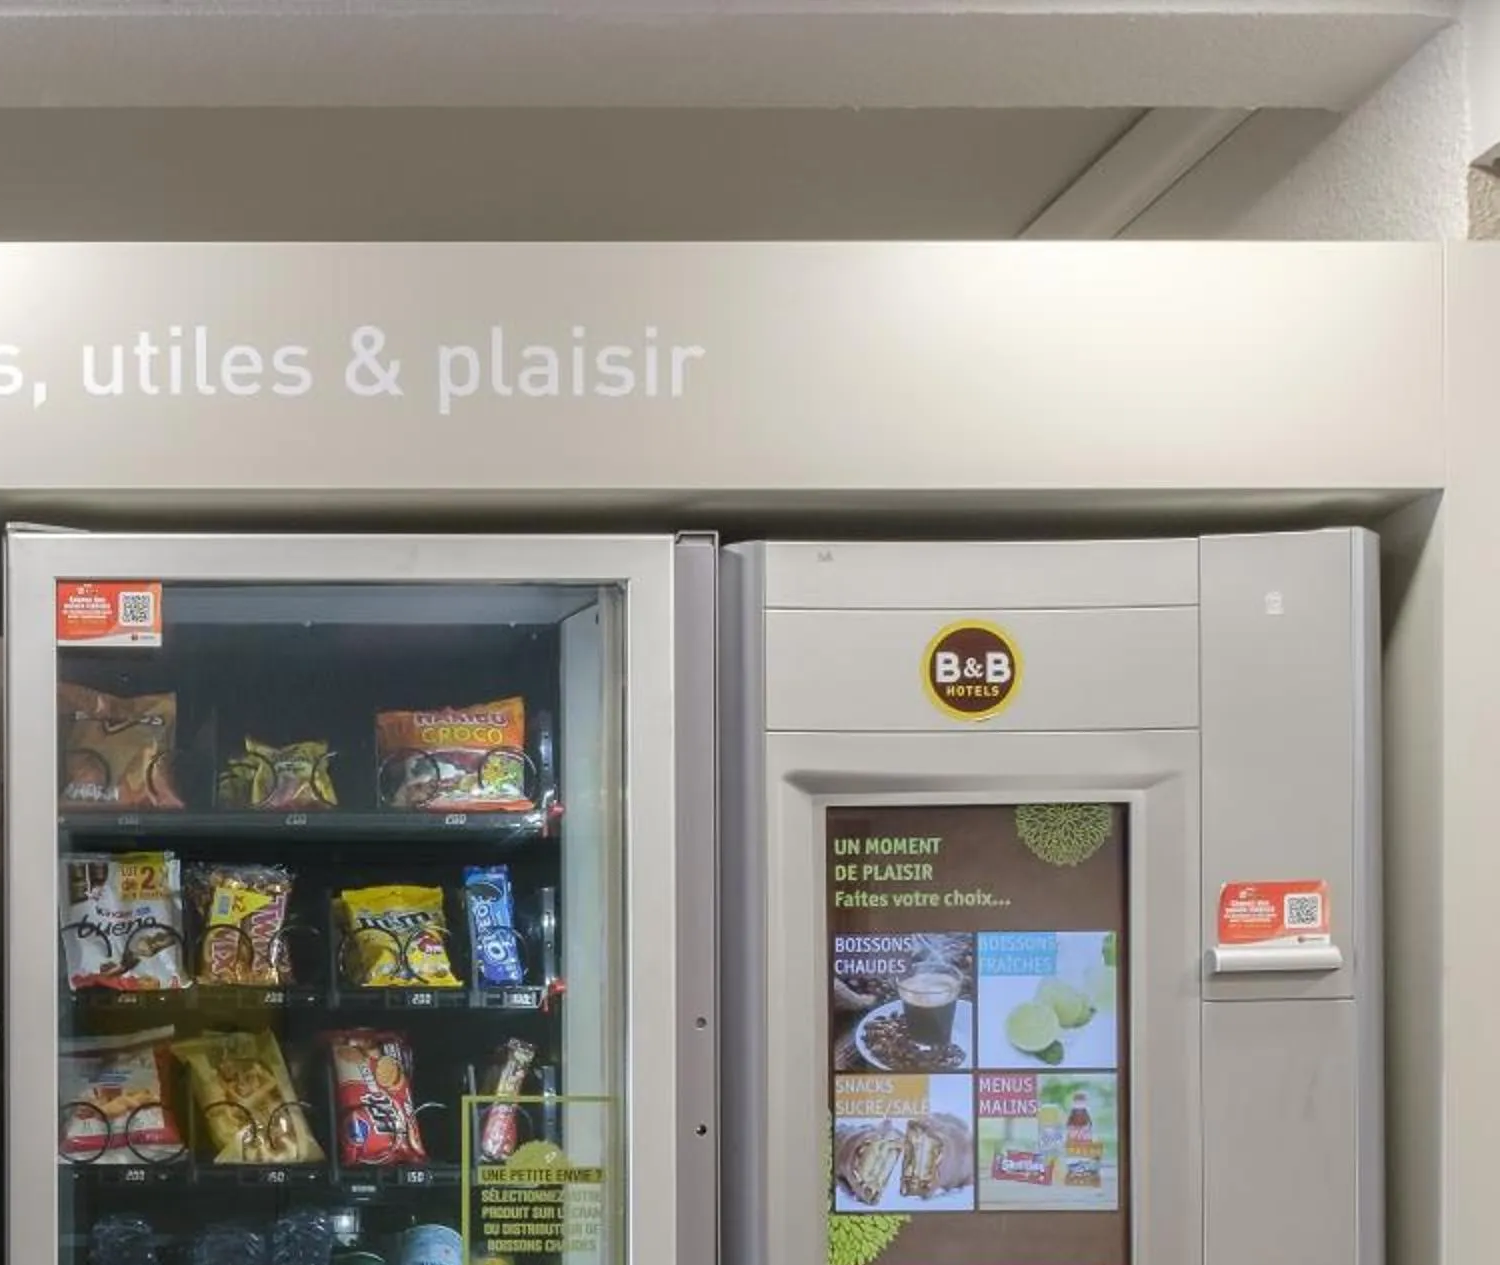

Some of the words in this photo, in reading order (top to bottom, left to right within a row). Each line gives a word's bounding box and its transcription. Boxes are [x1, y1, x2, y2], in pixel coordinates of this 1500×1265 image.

[82, 325, 314, 398] utiles
[344, 324, 405, 397] &
[436, 325, 706, 416] plaisir
[935, 651, 1011, 683] B&B
[946, 685, 1000, 697] HOTELS
[422, 727, 503, 744] CROCO
[834, 838, 860, 855] UN
[865, 838, 942, 855] MOMENT
[140, 866, 156, 889] 2
[835, 865, 858, 881] DE
[863, 864, 933, 881] PLAISIR
[893, 892, 940, 907] votre
[77, 914, 157, 939] bueno
[835, 937, 913, 953] BOISSONS
[835, 959, 906, 975] CHAUDES
[836, 1079, 894, 1093] SNACKS
[979, 1078, 1033, 1092] MENUS
[979, 1100, 1037, 1114] MALINS
[482, 1169, 507, 1181] UNE
[510, 1169, 553, 1181] PETITE
[481, 1206, 529, 1219] PRODUIT
[532, 1206, 556, 1219] SUR
[484, 1223, 499, 1235] DU
[487, 1239, 543, 1251] BOISSONS
